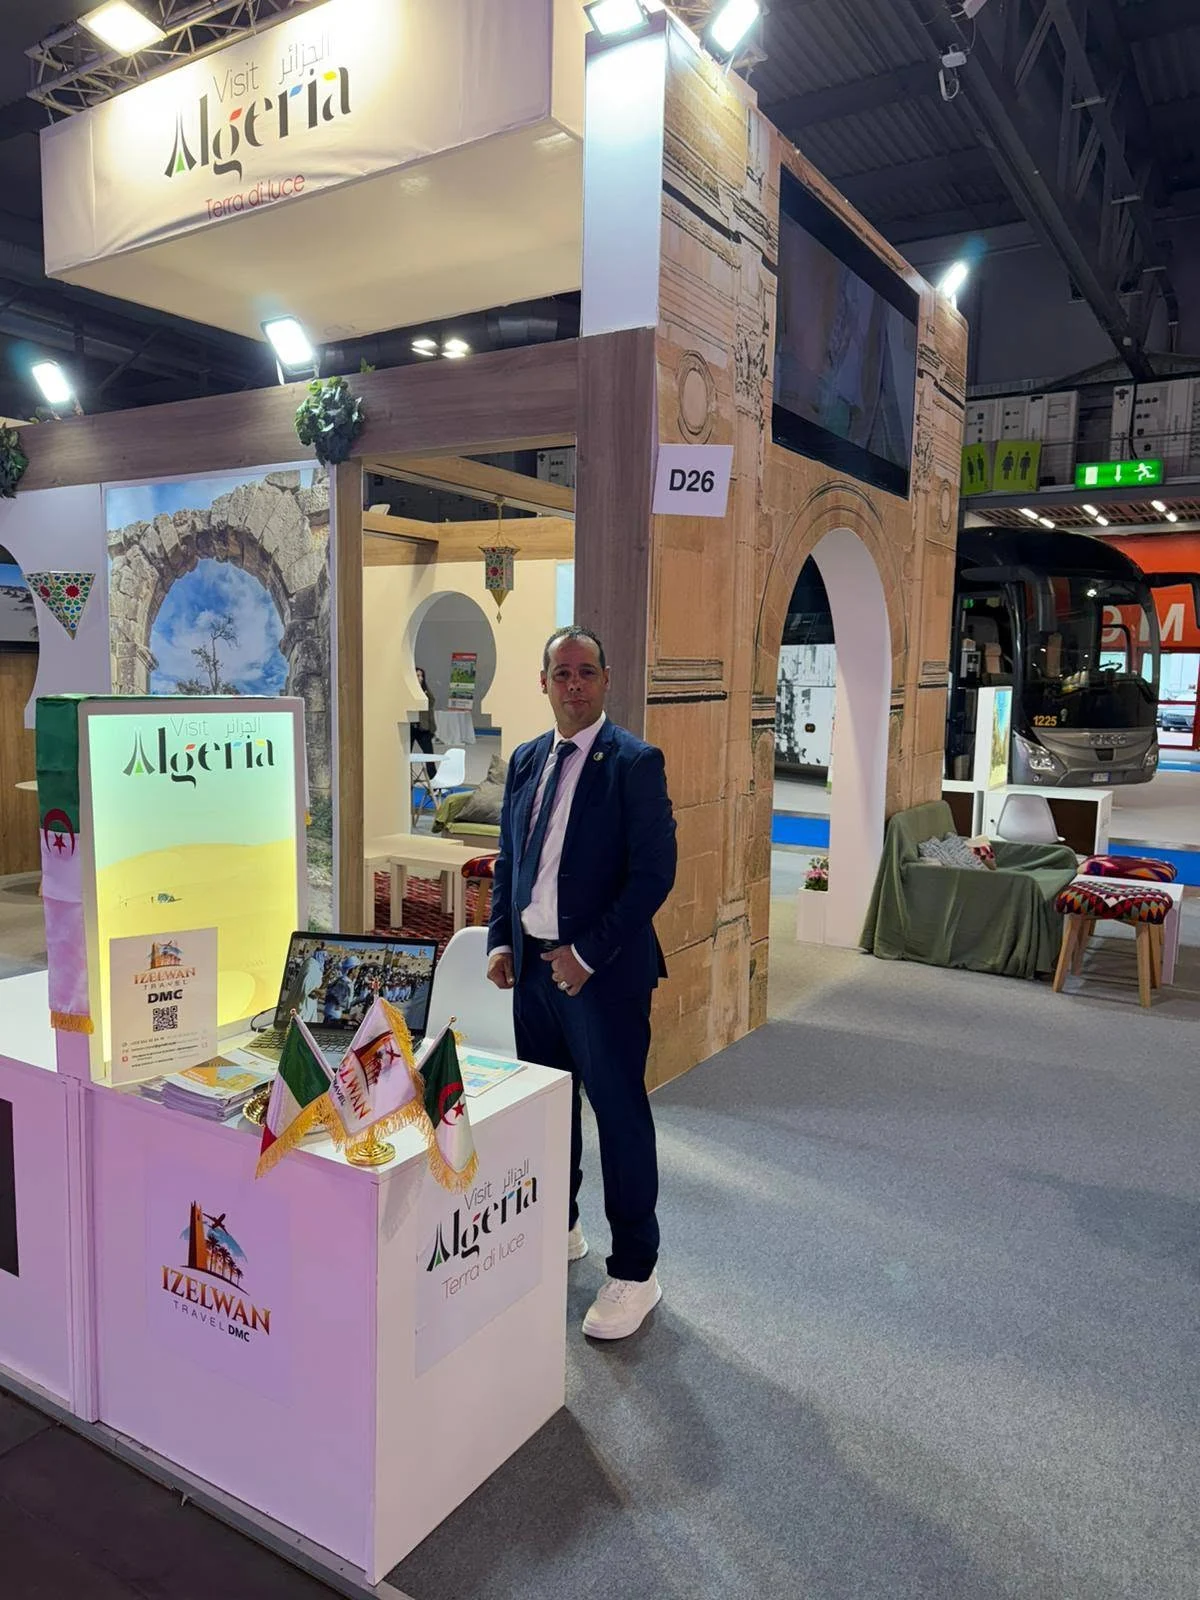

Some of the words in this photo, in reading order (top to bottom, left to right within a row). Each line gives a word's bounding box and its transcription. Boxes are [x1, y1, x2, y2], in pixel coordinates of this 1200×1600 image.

[278, 30, 331, 86] الجزائر
[213, 61, 259, 103] Visit
[164, 66, 351, 182] Algeria
[205, 191, 244, 220] Terra
[248, 180, 264, 207] di
[267, 174, 305, 200] luce
[669, 468, 715, 493] D26
[169, 716, 208, 737] Visit
[225, 715, 263, 738] الجزائر
[1033, 715, 1058, 727] 1225
[123, 725, 274, 789] Algeria
[133, 967, 196, 985] IZELWAN
[144, 980, 188, 991] TRAVEL
[147, 989, 183, 1004] DMC
[464, 1181, 493, 1210] Visit
[502, 1159, 529, 1194] الجزائر
[426, 1177, 538, 1272] Algeria
[441, 1265, 480, 1299] Terra
[483, 1251, 496, 1271] di
[499, 1233, 525, 1262] luce
[161, 1265, 271, 1336] IZELWAN
[173, 1300, 225, 1331] TRAVEL
[228, 1323, 250, 1343] DMC
